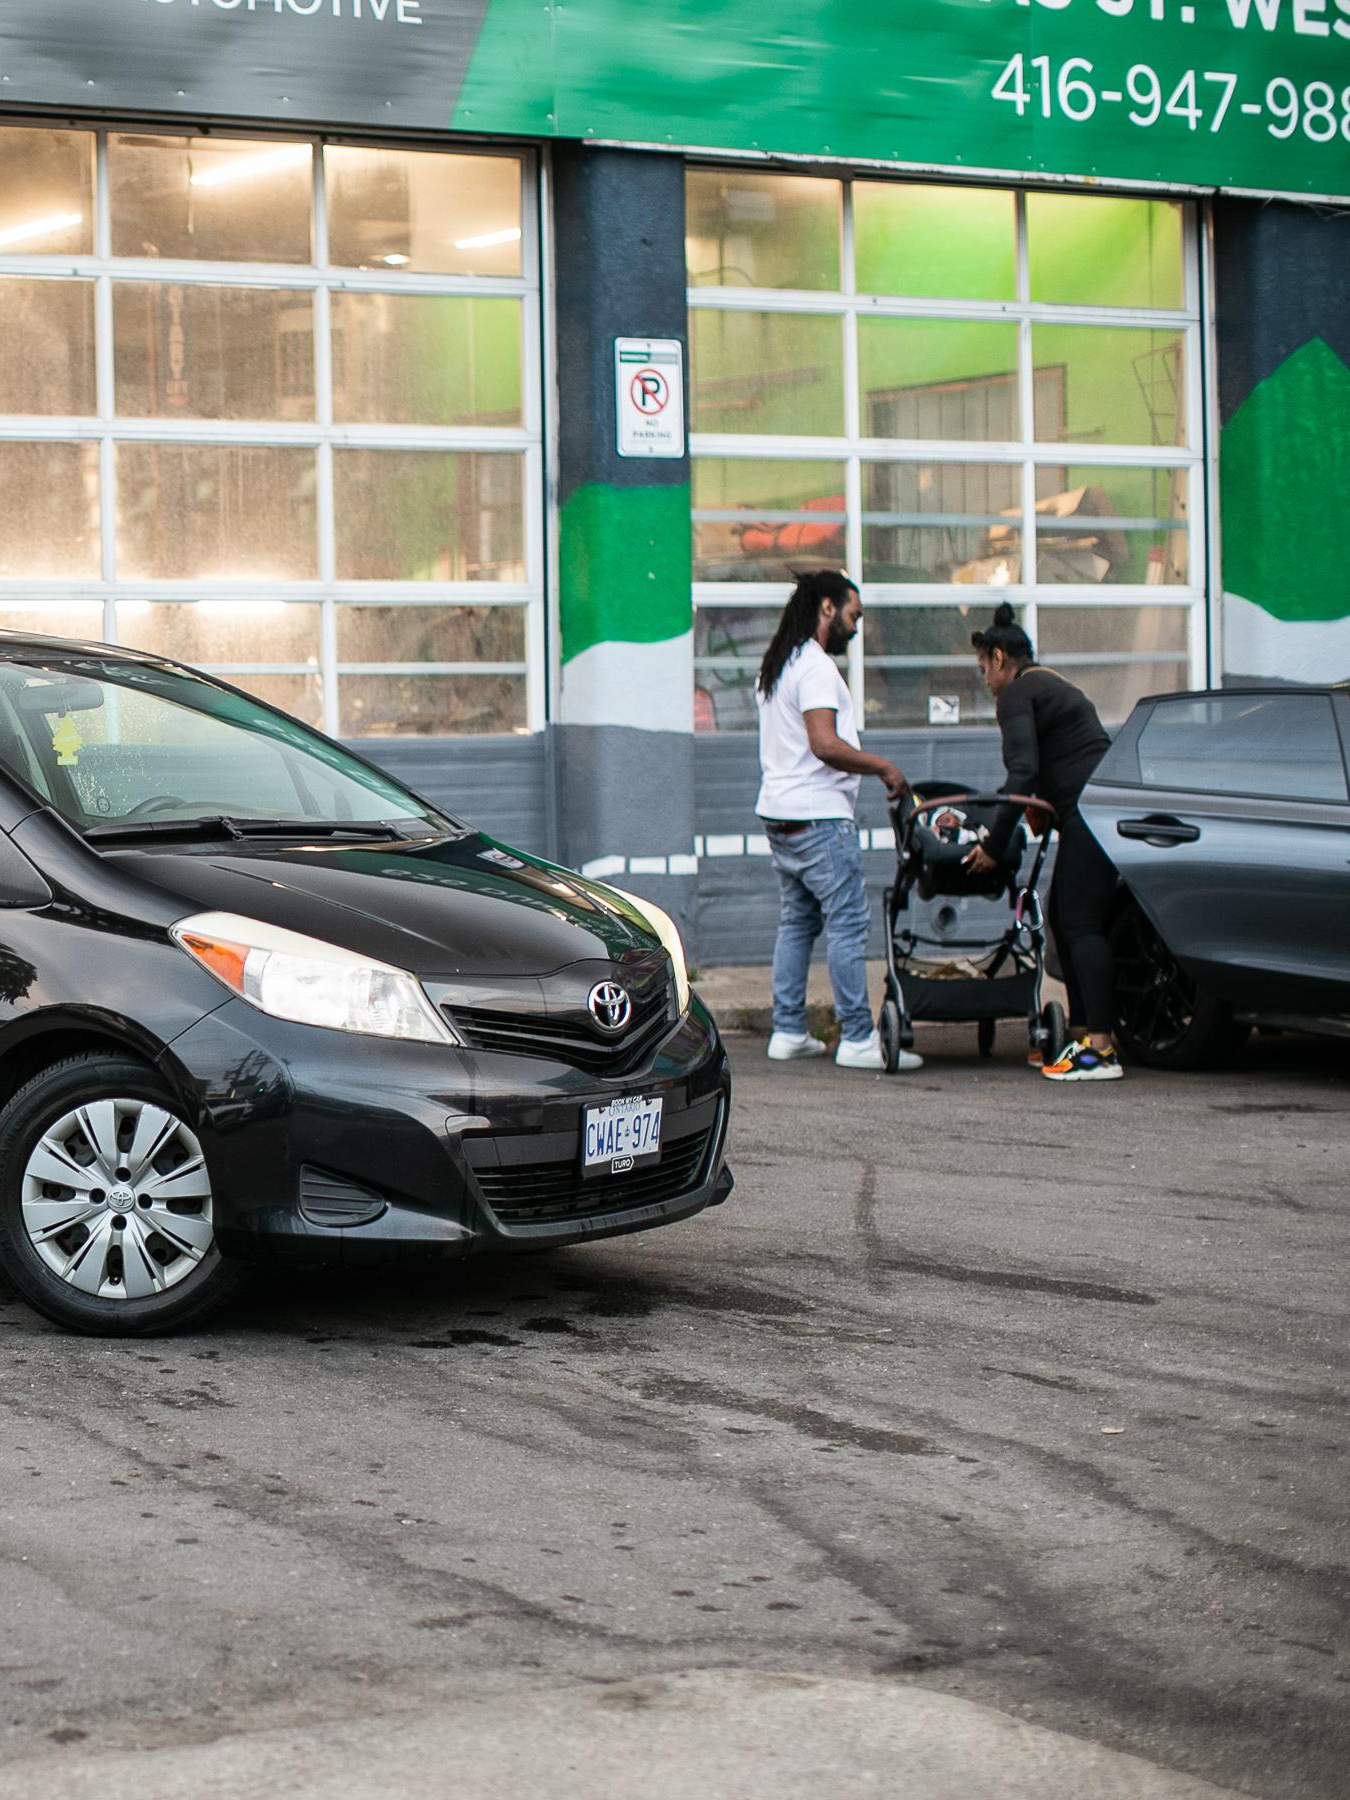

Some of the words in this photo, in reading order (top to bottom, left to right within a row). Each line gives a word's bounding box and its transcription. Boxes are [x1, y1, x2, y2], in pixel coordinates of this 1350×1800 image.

[991, 53, 1350, 142] 416-947-98
[633, 1095, 643, 1103] CAR
[609, 1101, 641, 1117] ONTARIO
[614, 1158, 631, 1169] TURO
